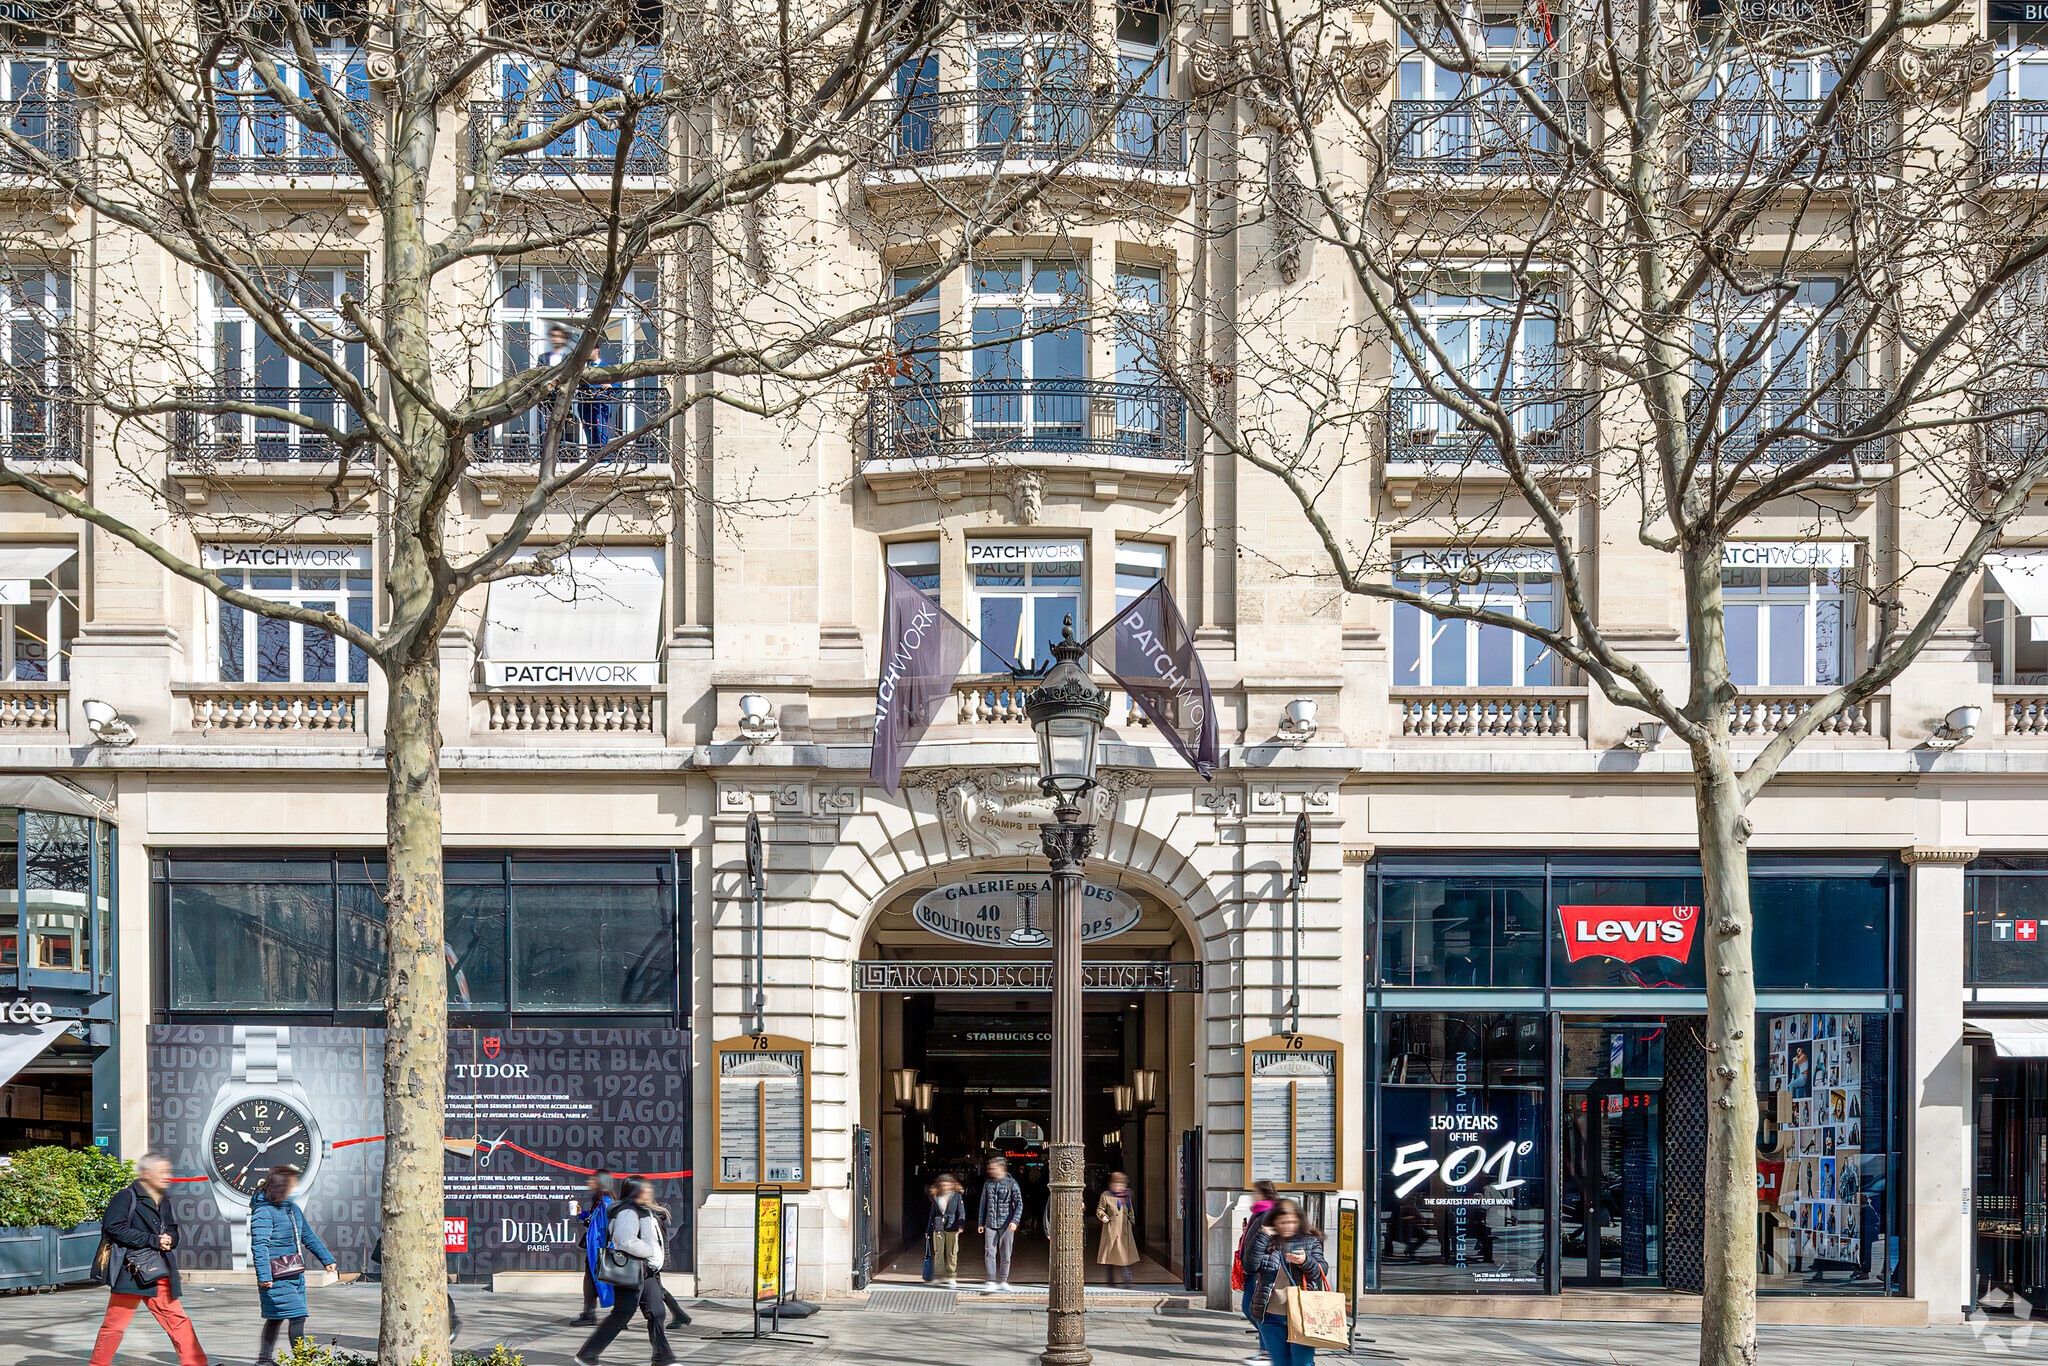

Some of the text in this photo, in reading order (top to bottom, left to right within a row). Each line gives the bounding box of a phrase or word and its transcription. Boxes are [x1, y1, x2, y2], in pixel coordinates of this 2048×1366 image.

[223, 549, 352, 566] PATCHWORK
[971, 545, 1079, 558] PATCHWORK
[1722, 548, 1832, 564] ATCHWORK
[504, 666, 637, 682] PATCHWORK
[874, 602, 937, 733] ATCHWORK
[980, 816, 1023, 830] CHAMPS
[945, 879, 1014, 901] GALERIE
[1018, 882, 1037, 891] DES
[977, 904, 1000, 922] 40
[922, 905, 1112, 940] BOUTIQUES OPS
[891, 966, 978, 986] ARCADES
[982, 966, 1015, 986] DES
[751, 1036, 768, 1049] 78
[966, 1032, 1052, 1041] STARBUCKS CO
[1285, 1036, 1304, 1049] 76
[611, 1049, 685, 1071] BLAC
[454, 1064, 529, 1079] TUDOR
[1456, 1052, 1467, 1097] WORN
[593, 1075, 655, 1097] 1926
[255, 1104, 268, 1118] 12
[1430, 1116, 1498, 1130] 150 YEARS
[1449, 1132, 1478, 1141] OF THE
[219, 1141, 229, 1155] 9
[294, 1141, 305, 1155] 3
[567, 1151, 639, 1172] ROSE
[1391, 1140, 1526, 1198] 501
[1424, 1198, 1435, 1206] THE
[1435, 1198, 1463, 1206] GREATEST
[1463, 1198, 1480, 1206] STORY
[1481, 1198, 1496, 1206] EVER
[444, 1220, 465, 1234] RN
[501, 1218, 577, 1244] DUBAIL
[1456, 1207, 1467, 1269] GREATES
